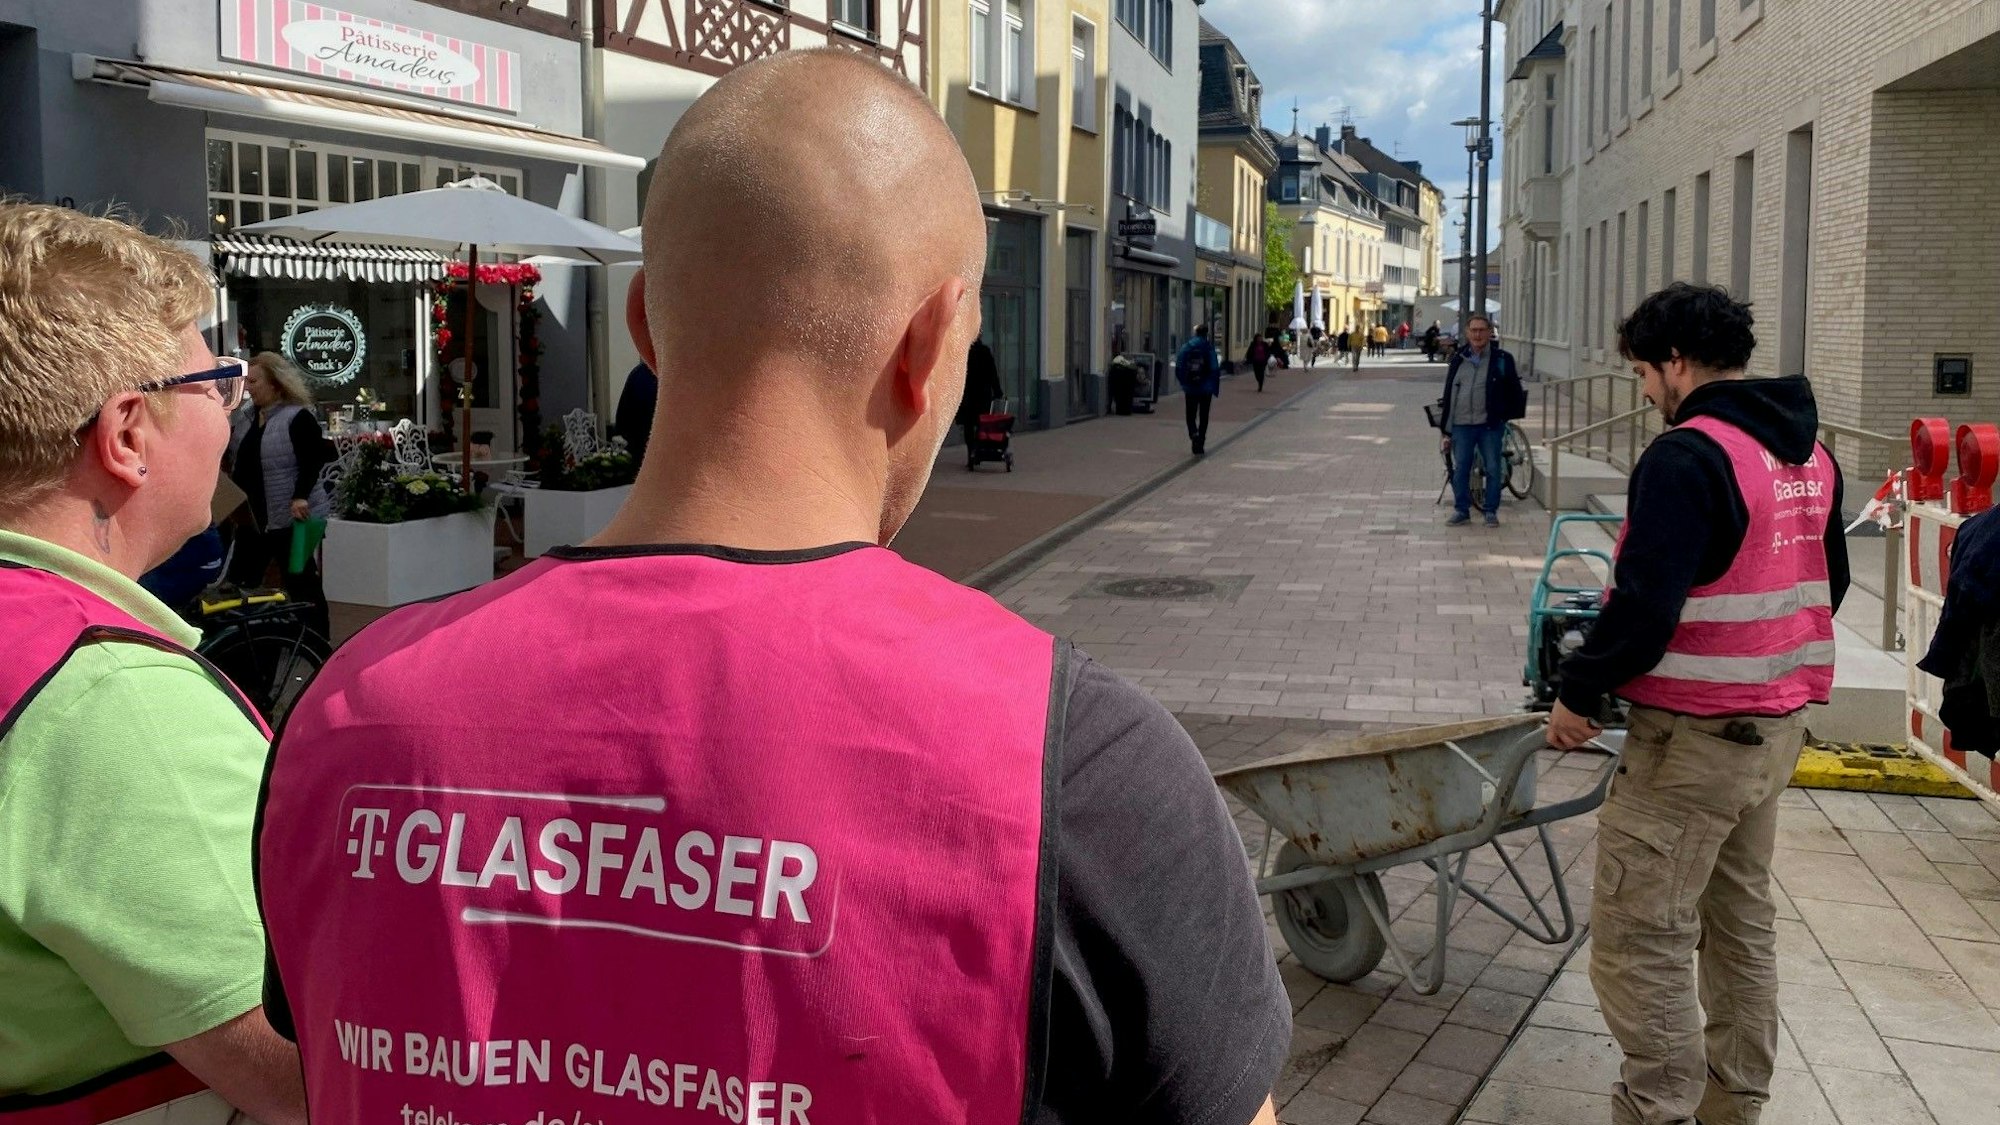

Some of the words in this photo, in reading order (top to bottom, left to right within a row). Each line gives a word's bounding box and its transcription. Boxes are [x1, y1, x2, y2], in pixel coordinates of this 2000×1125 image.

[315, 41, 456, 84] Amadeus
[341, 26, 438, 61] Pâtisserie
[295, 335, 353, 352] Amadeus
[321, 351, 328, 359] &
[394, 809, 819, 924] GLASFASER
[334, 1019, 394, 1073] WIR
[404, 1031, 550, 1087] BAUEN
[564, 1044, 813, 1125] GLASFASER
